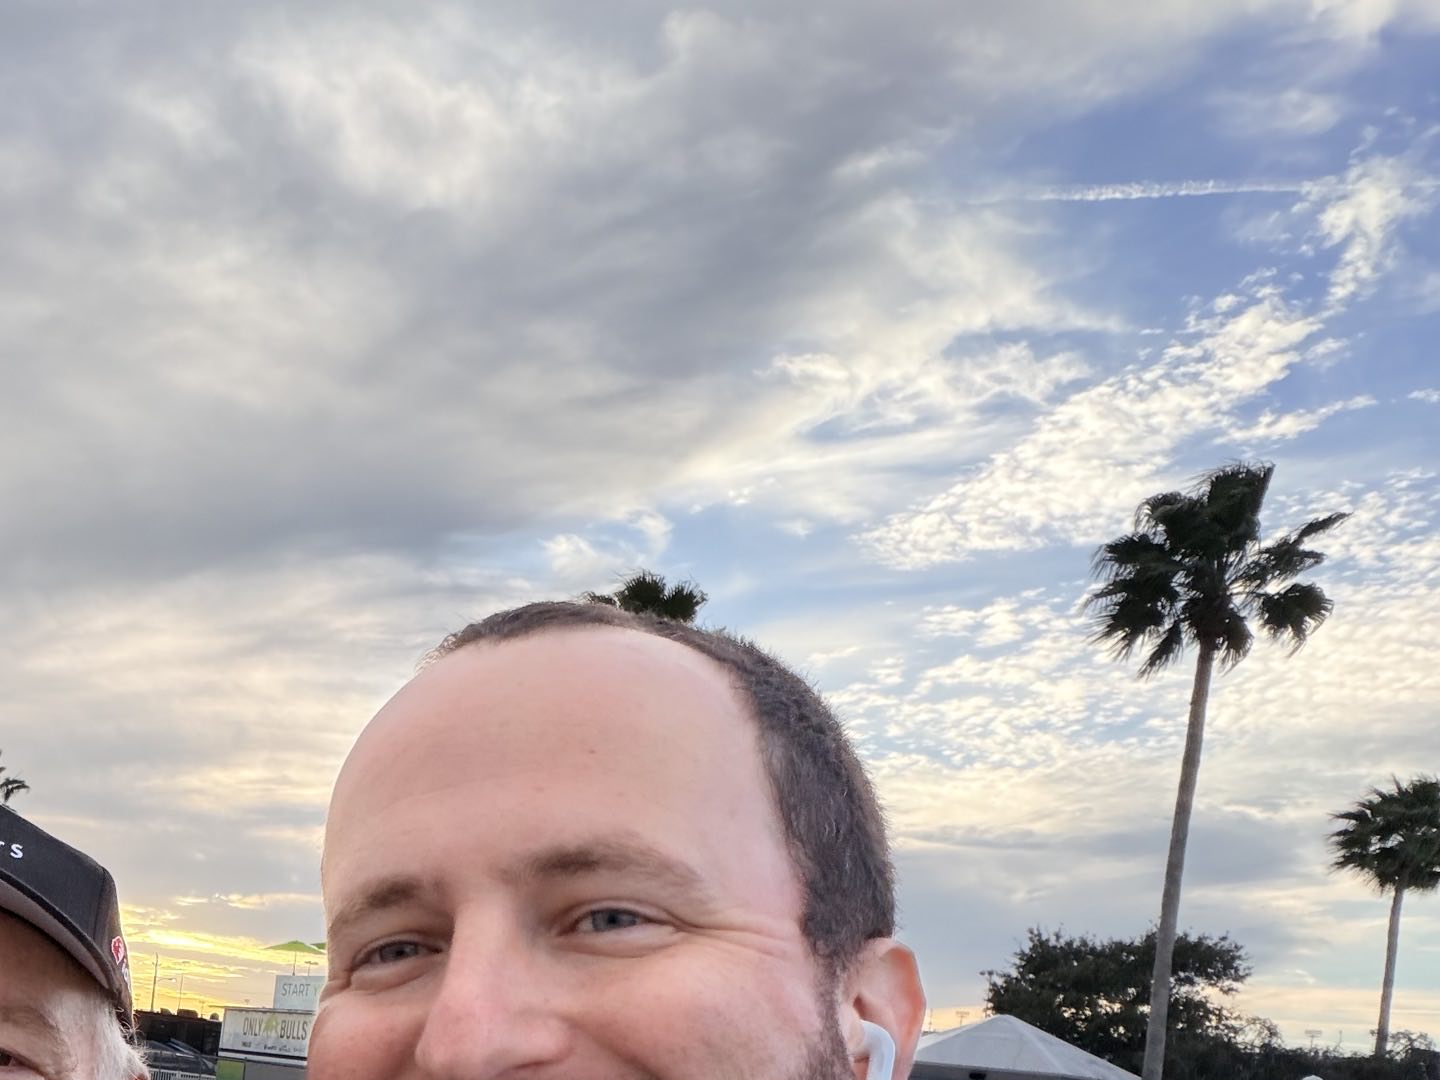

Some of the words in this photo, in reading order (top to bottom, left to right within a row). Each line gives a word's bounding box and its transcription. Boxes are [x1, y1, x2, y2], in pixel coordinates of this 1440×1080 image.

[281, 983, 311, 998] START
[243, 1017, 264, 1037] ONLY
[279, 1020, 308, 1041] BULLS
